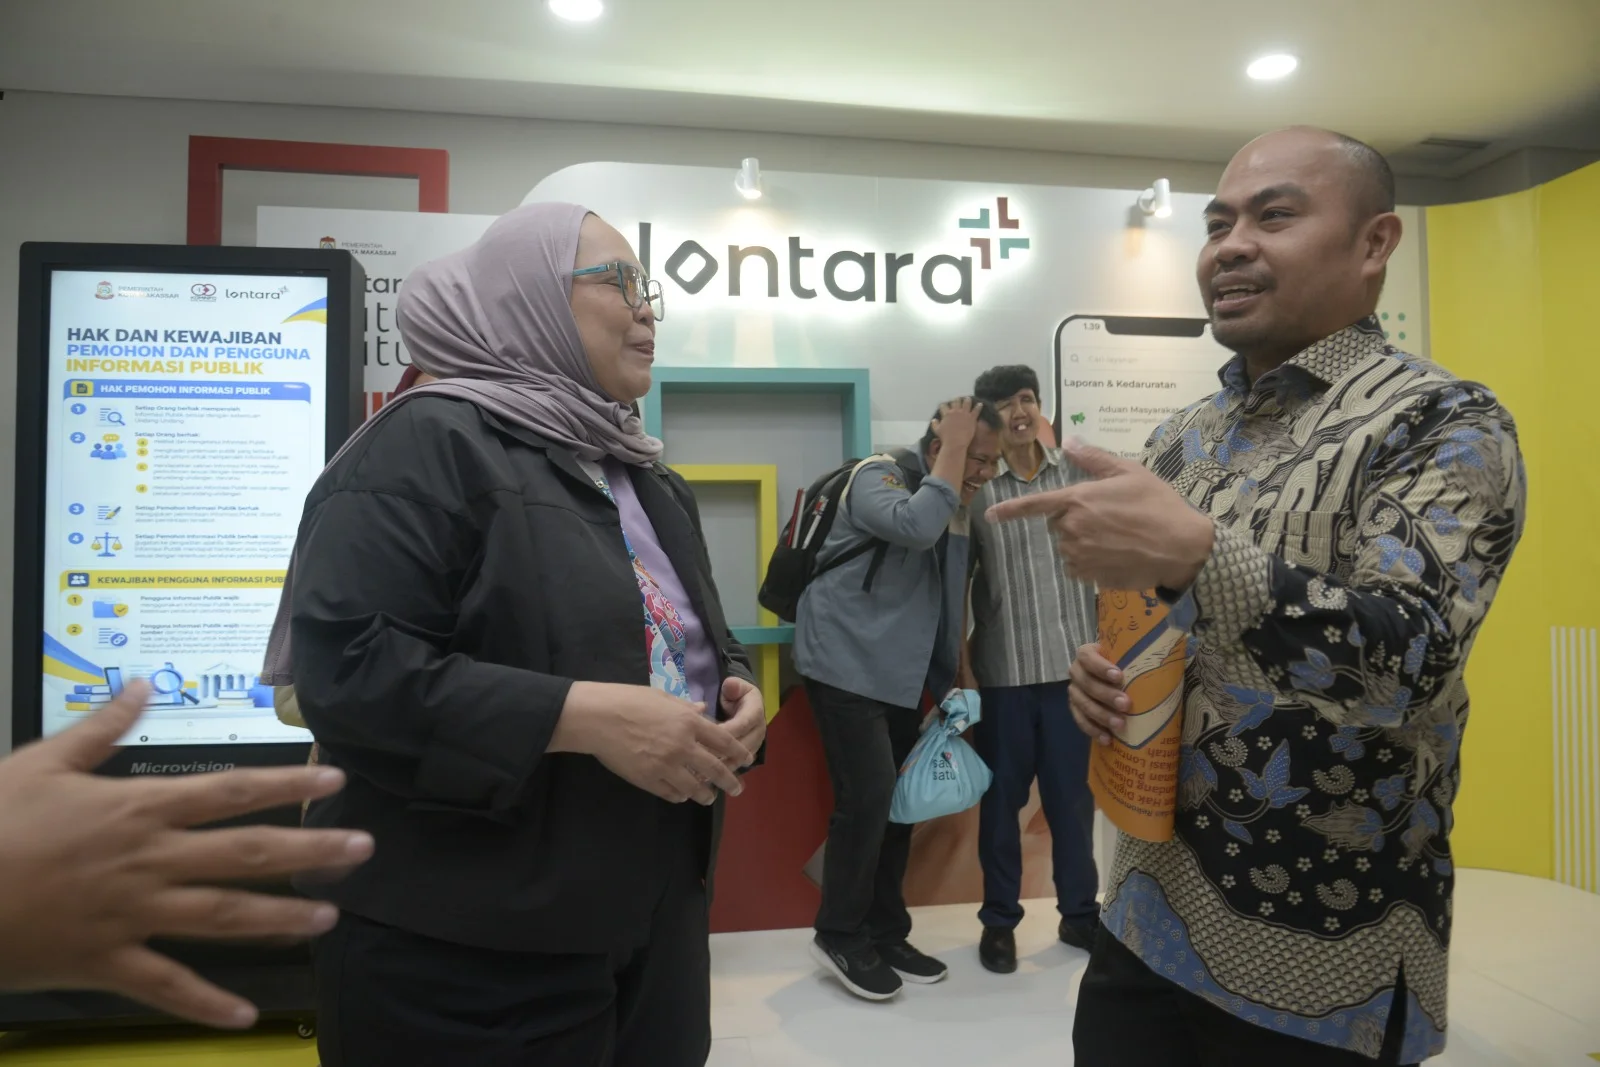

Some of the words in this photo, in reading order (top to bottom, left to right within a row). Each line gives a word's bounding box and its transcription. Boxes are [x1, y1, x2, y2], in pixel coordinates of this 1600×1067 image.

[638, 221, 973, 307] lontara
[225, 288, 281, 300] lontara
[67, 327, 109, 342] HAK
[116, 329, 158, 342] DAN
[164, 330, 282, 345] KEWAJIBAN
[67, 344, 165, 358] PEMOHON
[170, 346, 209, 358] DAN
[214, 347, 311, 360] PENGGUNA
[66, 359, 184, 373] INFORMASI
[190, 361, 264, 375] PUBLIK
[100, 384, 123, 393] HAK
[125, 384, 176, 394] PEMOHON
[178, 386, 233, 395] INFORMASI
[235, 387, 271, 395] PUBLIK
[1064, 378, 1104, 389] Laporan
[1106, 379, 1113, 388] &
[1115, 379, 1177, 389] Kedaruratan
[1098, 405, 1128, 413] Aduan
[1130, 406, 1180, 415] Masyarakat
[97, 576, 155, 584] KEWAJIBAN
[157, 576, 209, 584] PENGGUNA
[211, 576, 263, 584] INFORMASI
[130, 761, 236, 775] Microvision
[1113, 759, 1146, 780] Publik
[932, 770, 955, 781] satu
[1138, 795, 1161, 807] Hak
